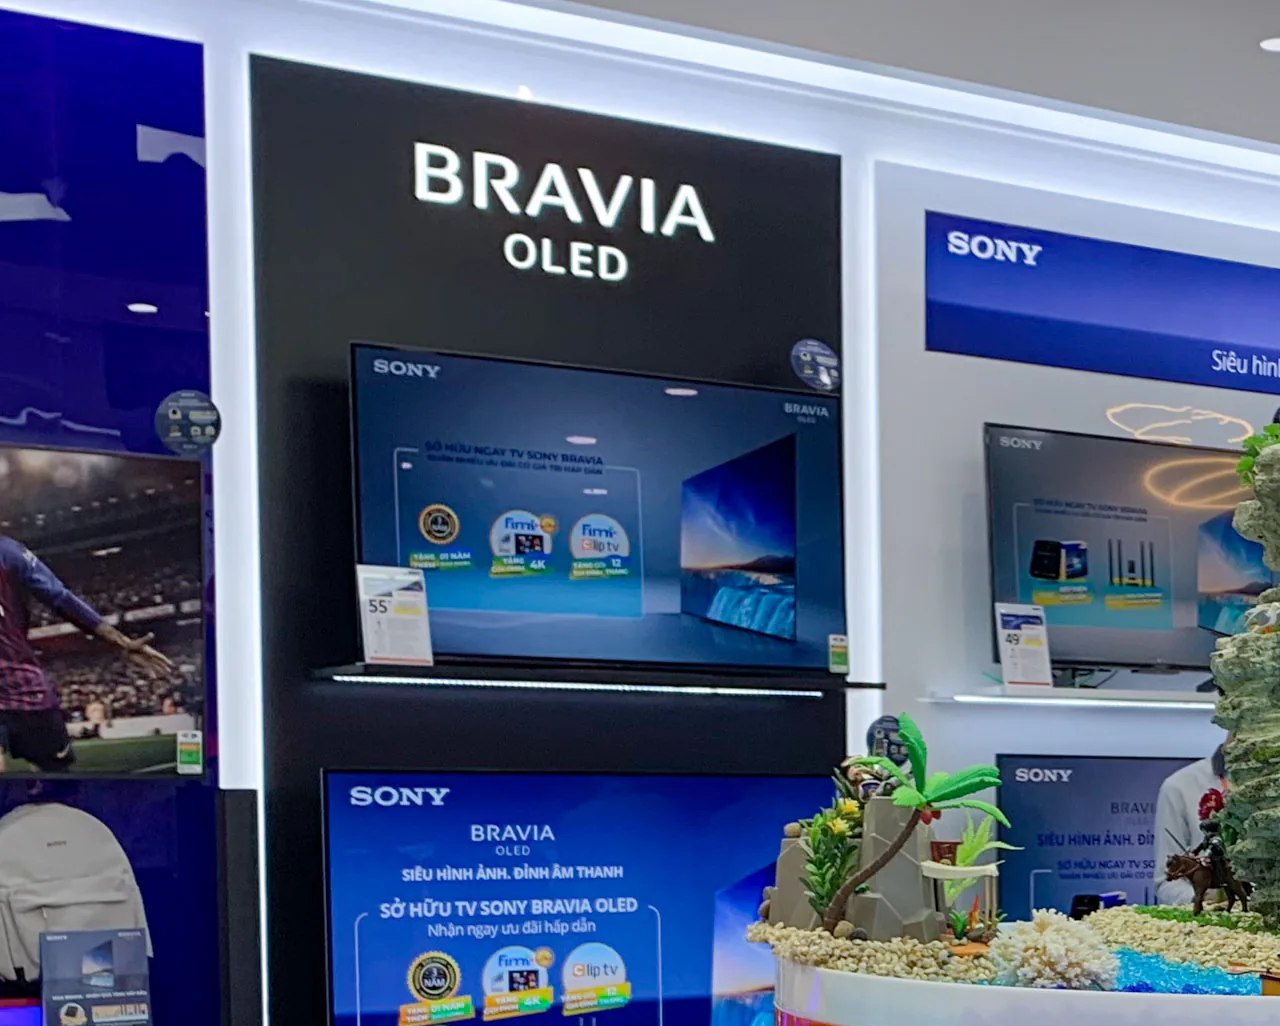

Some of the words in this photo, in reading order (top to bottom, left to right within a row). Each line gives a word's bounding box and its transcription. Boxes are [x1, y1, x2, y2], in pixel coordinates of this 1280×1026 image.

[413, 141, 716, 242] BRAVIA
[503, 233, 628, 282] OLED
[947, 231, 1043, 266] SONY
[373, 359, 441, 378] SONY
[1211, 349, 1248, 374] Siêu
[784, 402, 829, 418] BRAVIA
[1000, 436, 1042, 450] SONY
[527, 450, 559, 462] SONY
[561, 454, 604, 466] BRAVIA
[1015, 768, 1072, 782] SONY
[350, 786, 450, 806] SONY
[471, 824, 556, 841] BRAVIA
[1068, 831, 1101, 847] HÌNH
[495, 845, 531, 857] OLED
[402, 865, 433, 882] SIÊU
[436, 865, 473, 881] HÌNH
[514, 863, 549, 880] ĐỈNH
[552, 863, 574, 880] ÂM
[576, 866, 624, 879] THANH
[1099, 860, 1125, 869] NGAY
[1128, 860, 1141, 869] TV
[380, 897, 406, 919] SỞ
[409, 898, 452, 918] HỮU
[454, 900, 477, 917] TV
[480, 899, 528, 916] SONY
[531, 898, 592, 915] BRAVIA
[595, 897, 638, 913] OLED
[428, 922, 463, 938] Nhận
[467, 924, 499, 940] ngay
[501, 921, 520, 935] ưu
[522, 919, 542, 934] đãi
[544, 918, 569, 937] hấp
